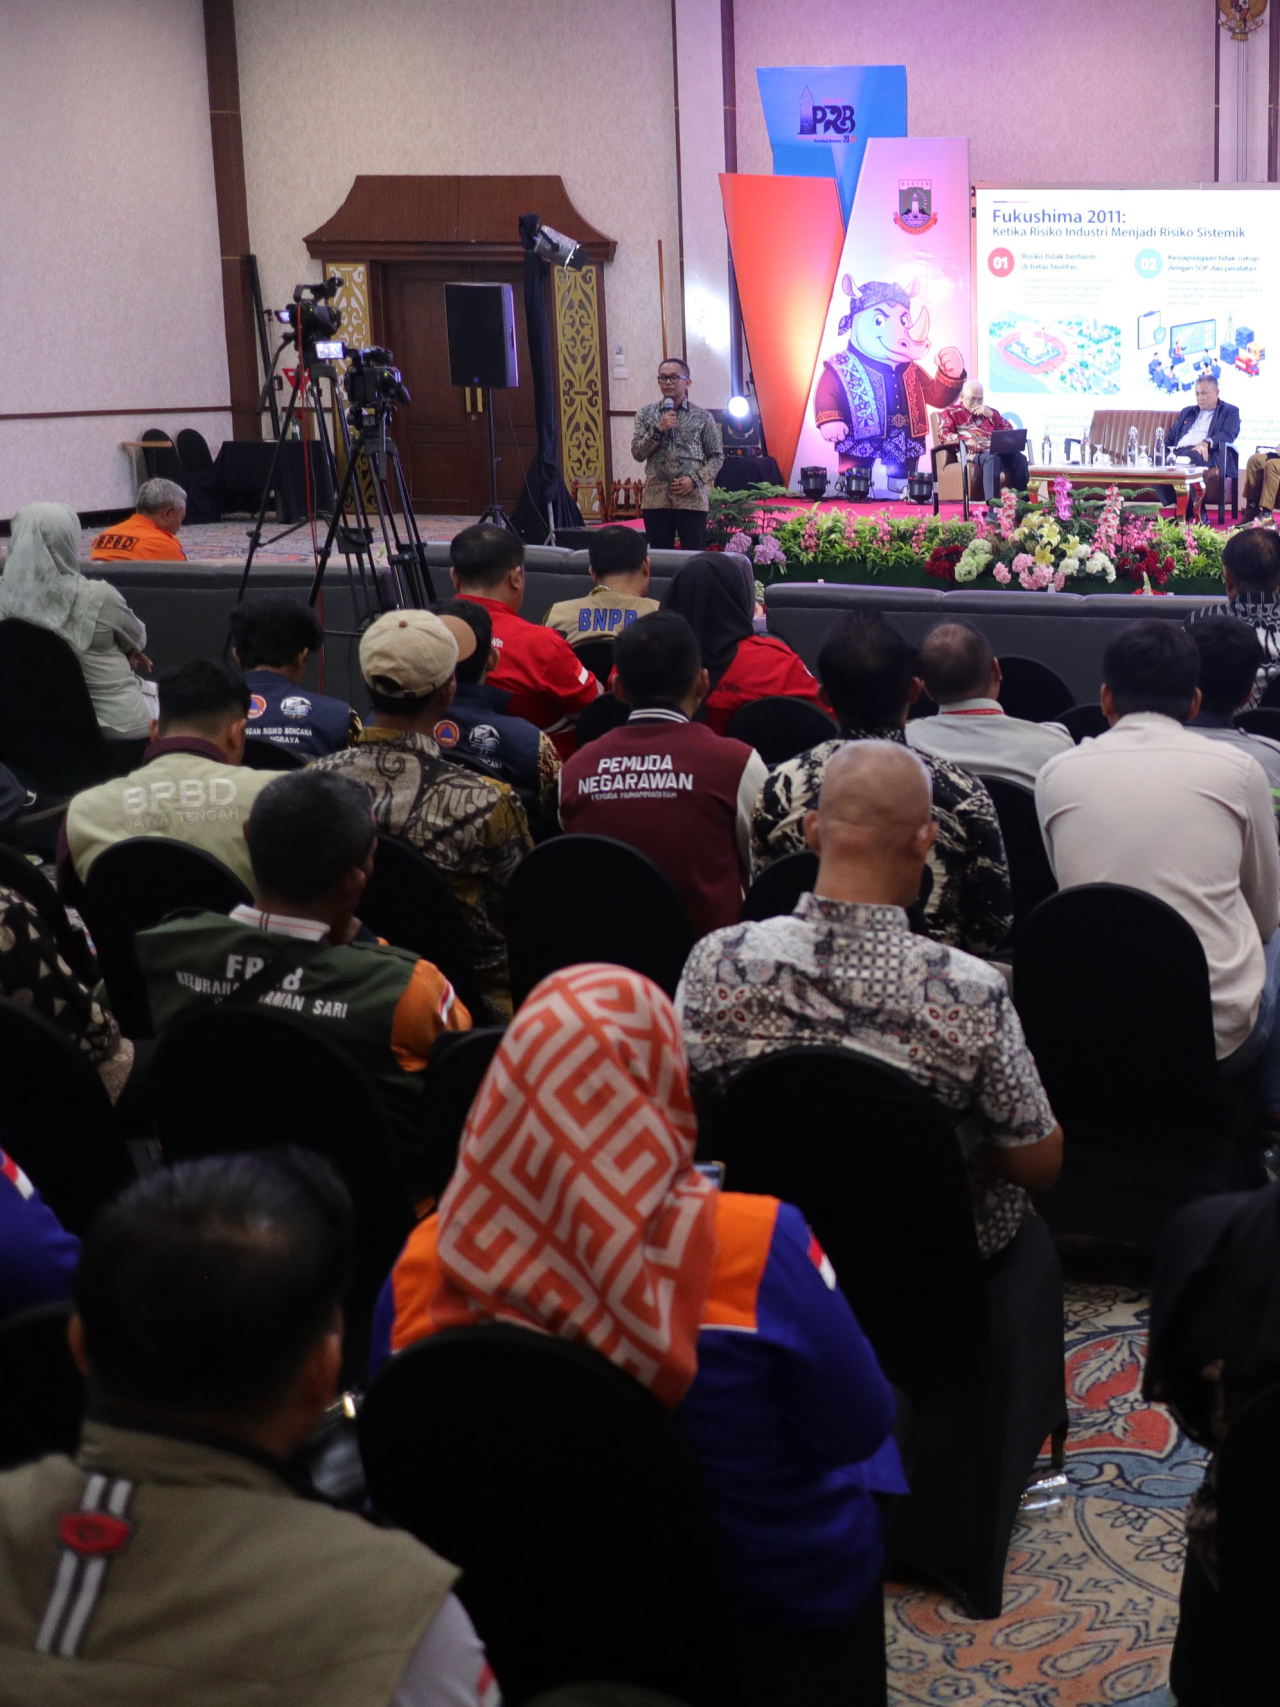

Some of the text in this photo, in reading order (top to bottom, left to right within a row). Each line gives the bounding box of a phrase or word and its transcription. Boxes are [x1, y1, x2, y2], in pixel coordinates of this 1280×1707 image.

[993, 209, 1126, 223] Fukushima 2011:
[992, 226, 1246, 240] Ketika Risiko Industri Menjadi Risiko Sistemik
[993, 256, 1008, 270] 01
[1065, 253, 1097, 261] berhenti
[1140, 257, 1158, 271] 02
[1168, 265, 1193, 273] dengan
[96, 535, 134, 549] BPBD
[263, 727, 282, 735] RISIKO
[284, 727, 313, 736] BENCANA
[597, 754, 674, 774] PEMUDA
[578, 772, 693, 795] NEGARAWAN
[123, 778, 237, 815] BPBD
[176, 808, 239, 823] TENGAH
[226, 954, 304, 990] FPB
[312, 999, 348, 1019] SARI
